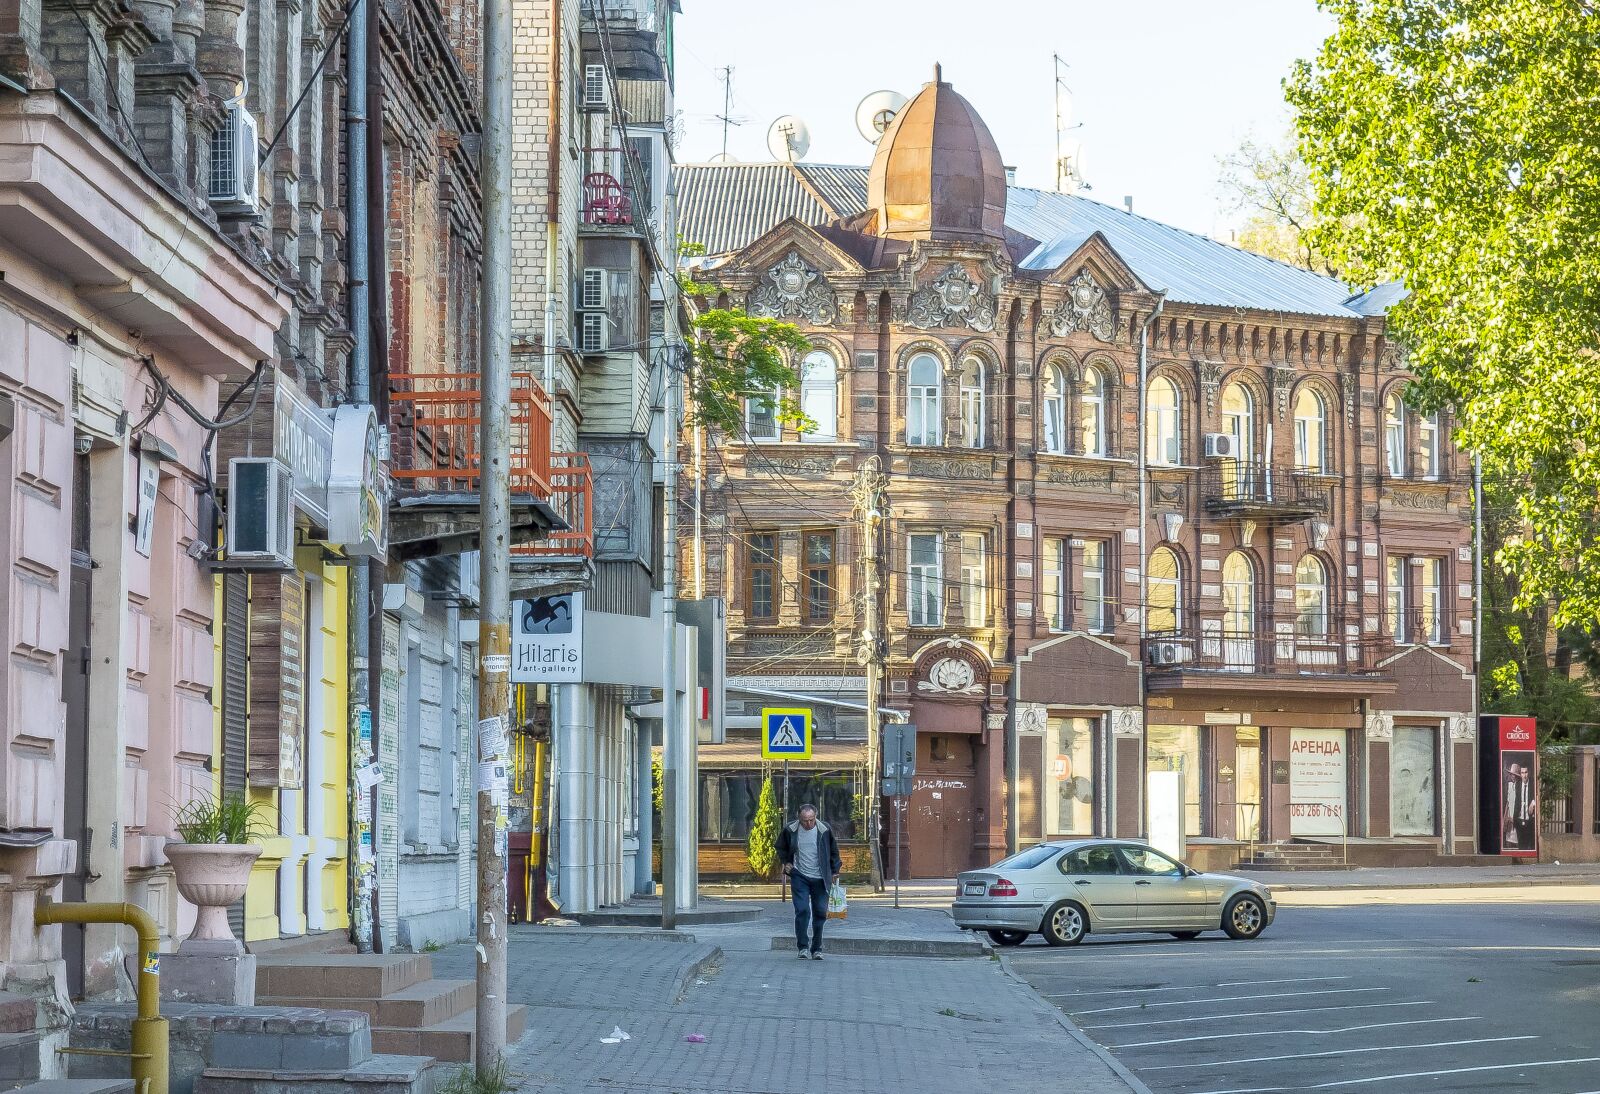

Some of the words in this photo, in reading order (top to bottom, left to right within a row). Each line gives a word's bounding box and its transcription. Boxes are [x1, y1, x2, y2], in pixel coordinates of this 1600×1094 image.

[518, 643, 578, 671] Hilaris
[523, 665, 577, 673] art-gallery
[1506, 732, 1530, 740] CROCUS
[1292, 740, 1341, 756] АРЕНДА
[1291, 804, 1305, 817] 063
[1307, 804, 1321, 817] 266
